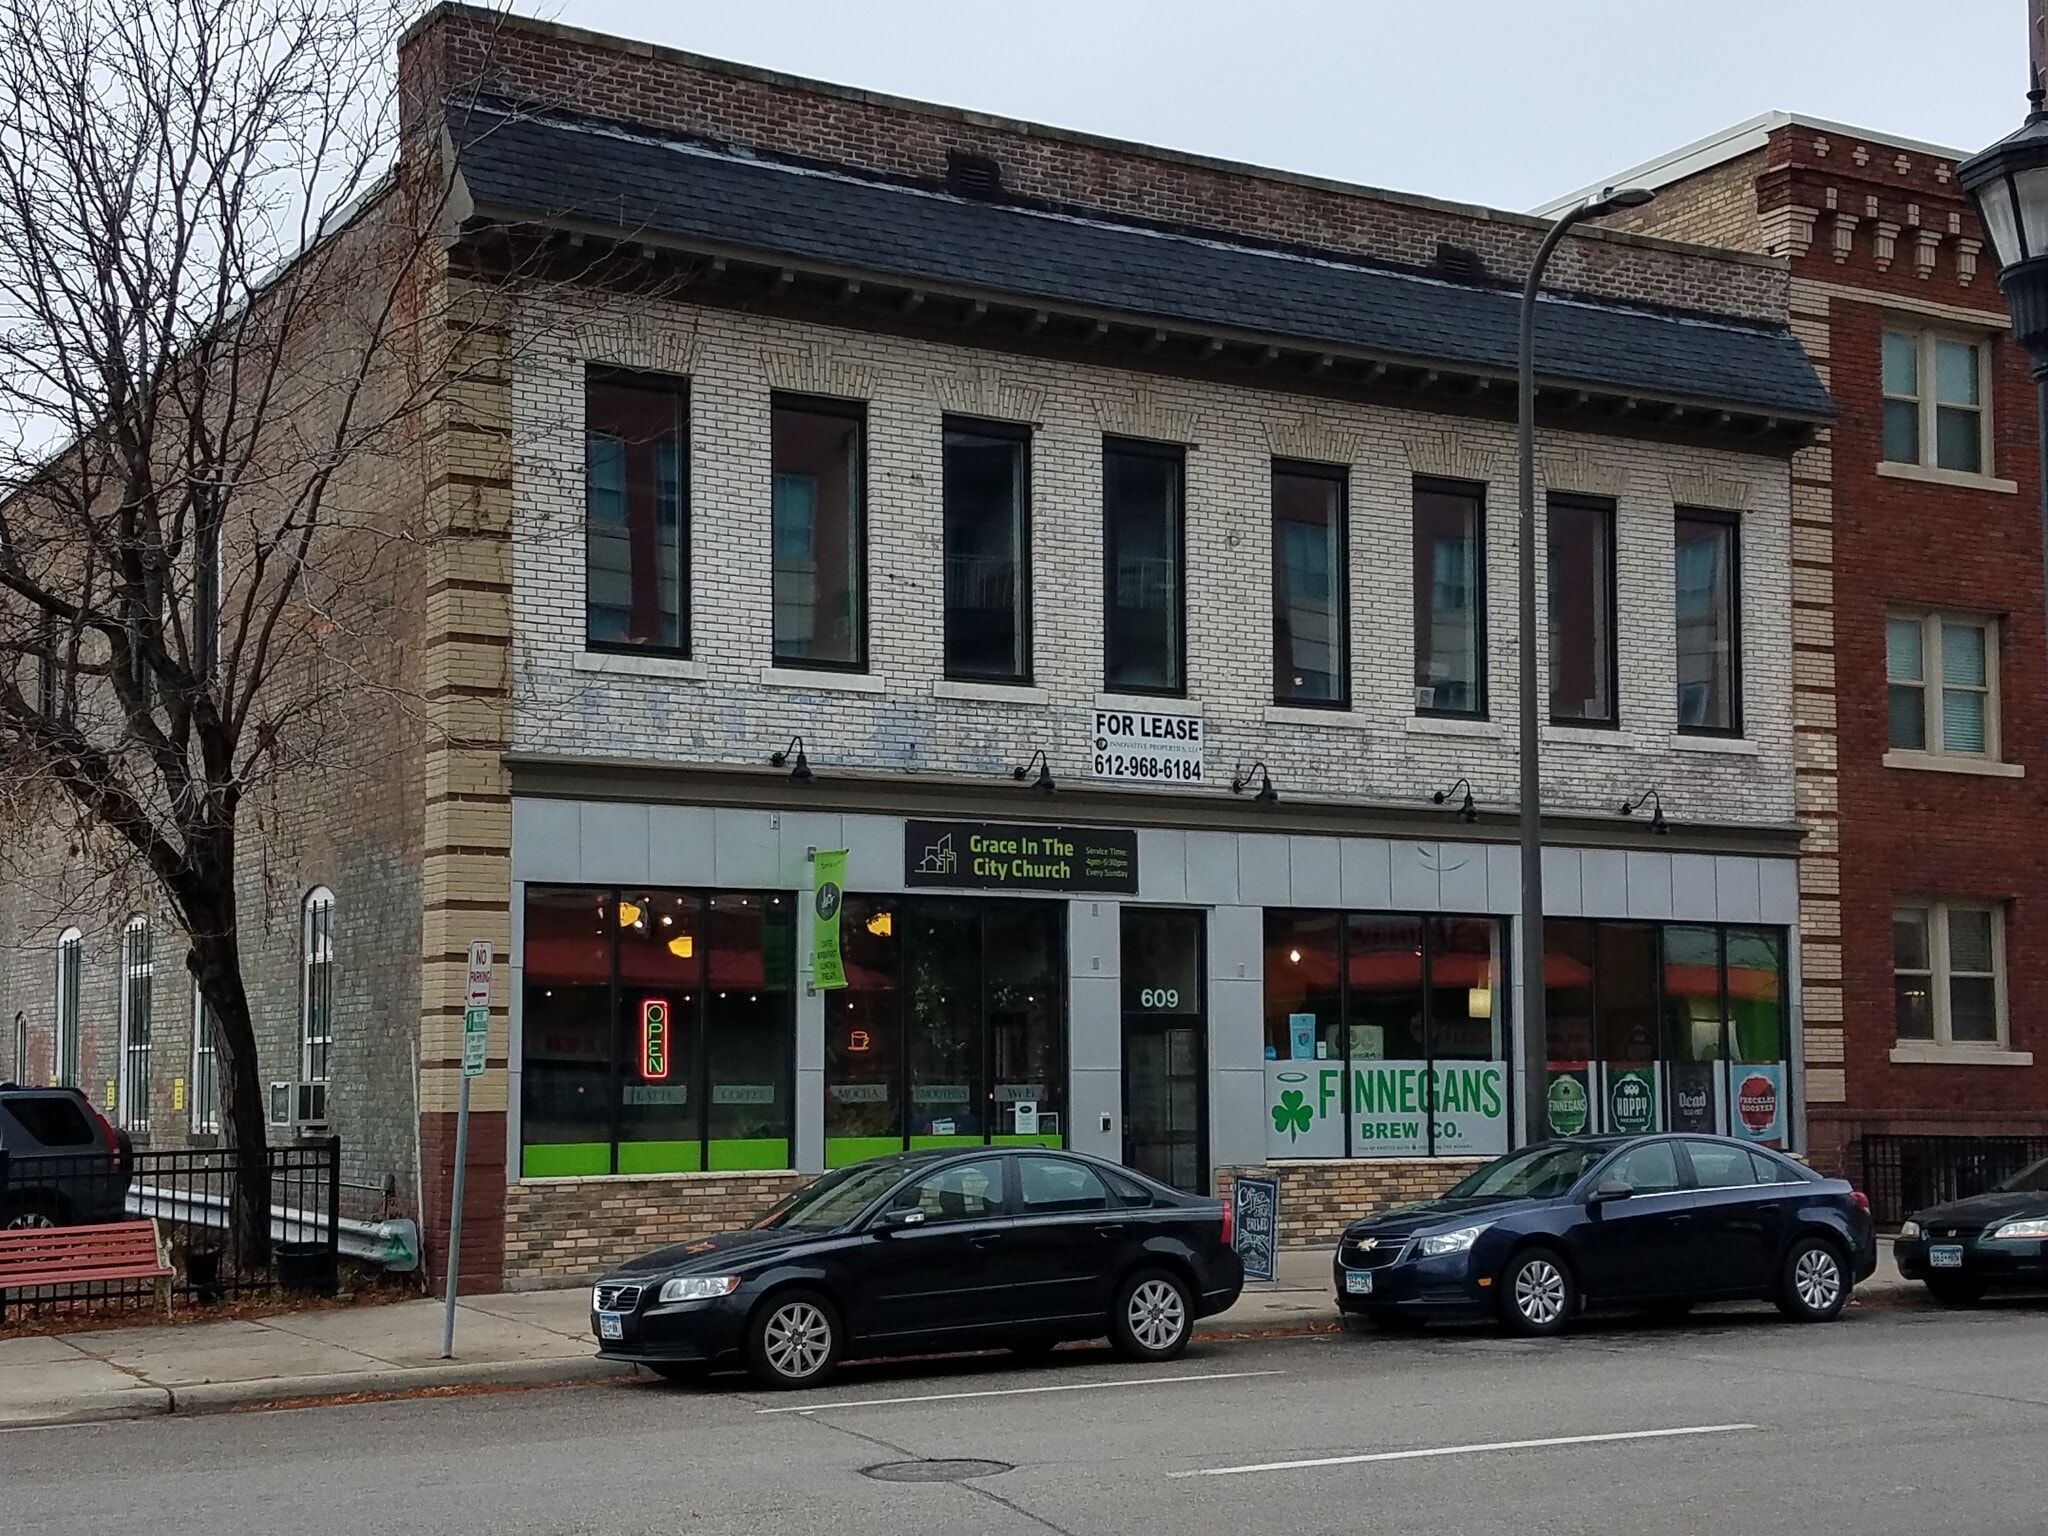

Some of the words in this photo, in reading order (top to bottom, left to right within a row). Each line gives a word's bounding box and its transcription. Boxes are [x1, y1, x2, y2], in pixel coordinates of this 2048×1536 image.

[1096, 713, 1135, 737] FOR
[1140, 716, 1199, 741] LEASE
[1094, 754, 1201, 781] 612-968-6184
[970, 835, 1017, 854] Grace
[1022, 837, 1038, 855] In
[1042, 838, 1074, 857] The
[1085, 846, 1108, 856] Service
[973, 858, 1008, 881] City
[1012, 859, 1071, 879] Church
[1086, 868, 1104, 878] Every
[1104, 869, 1129, 880] Sunday
[475, 949, 487, 966] NO
[470, 971, 490, 984] PARKING
[1141, 988, 1179, 1009] 609
[647, 1004, 664, 1074] OPEN
[838, 1088, 880, 1099] MOCHA
[1319, 1069, 1502, 1119] FINNEGANS
[1549, 1099, 1586, 1113] FINNEGANS
[1617, 1096, 1648, 1117] HOPPY
[1742, 1104, 1774, 1112] ROOSTER
[1362, 1122, 1419, 1139] BREW
[1428, 1121, 1463, 1139] CO.
